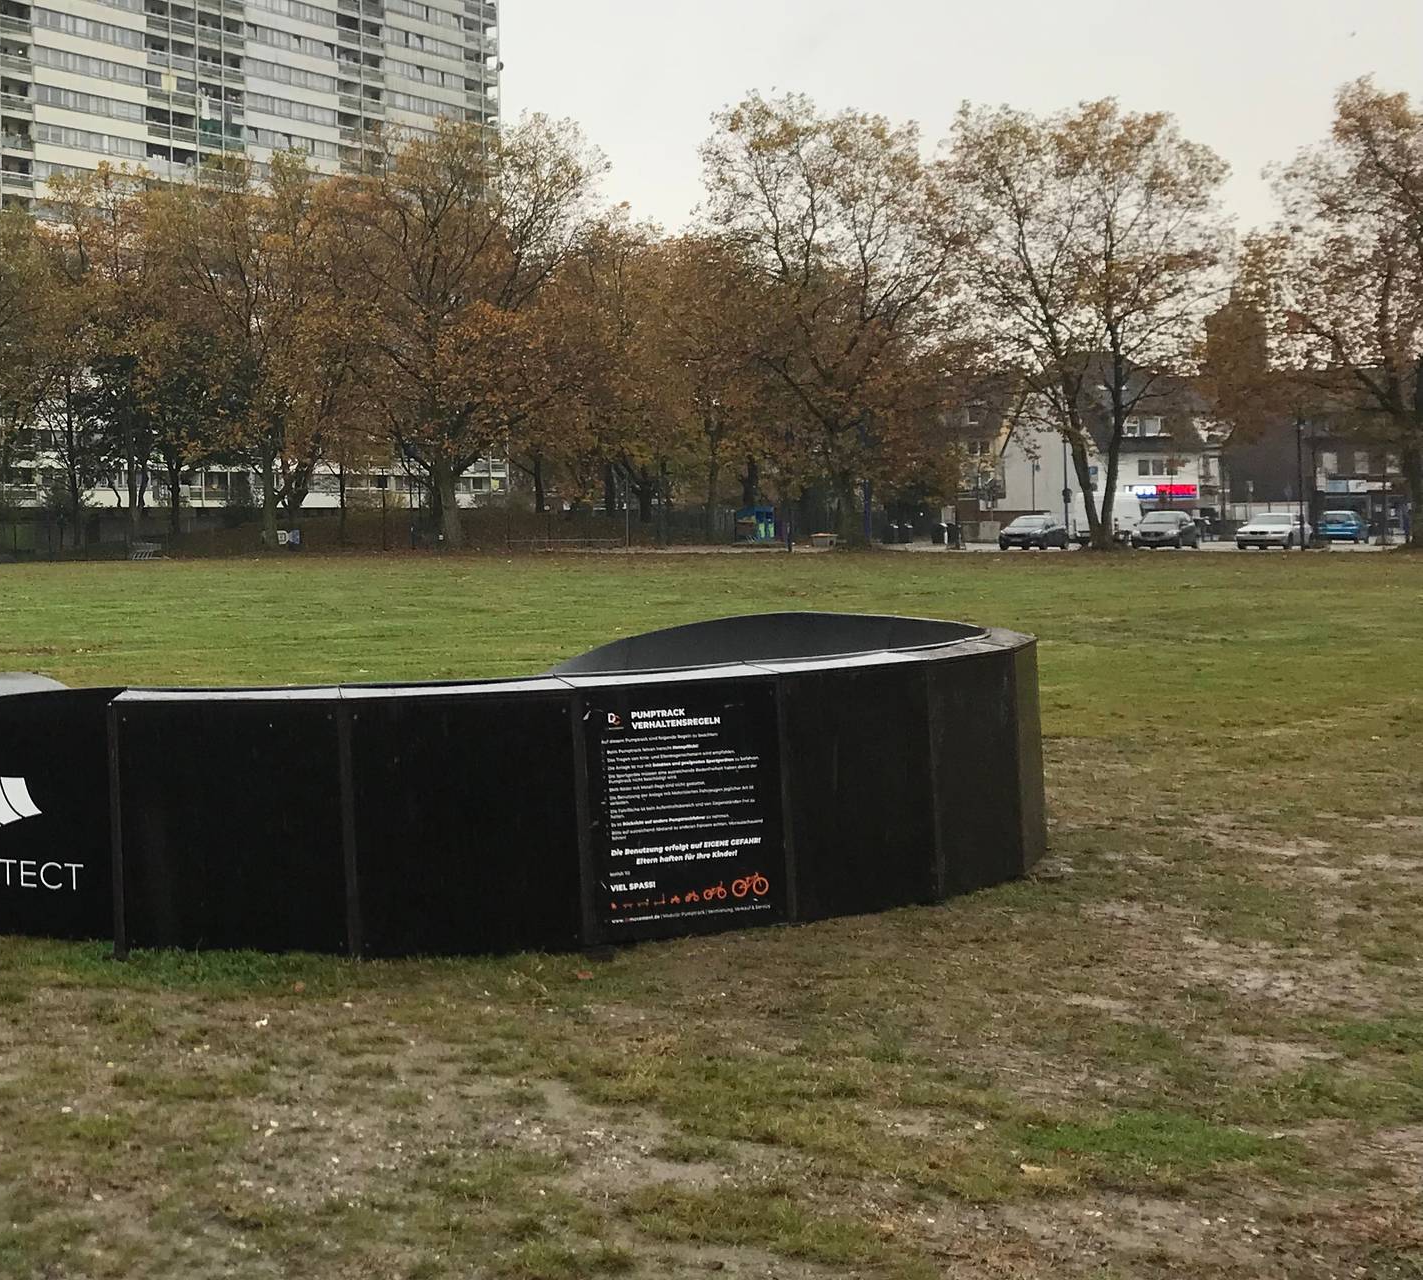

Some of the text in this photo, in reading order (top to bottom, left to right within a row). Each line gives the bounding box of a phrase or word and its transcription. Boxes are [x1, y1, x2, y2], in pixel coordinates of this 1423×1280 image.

[631, 708, 686, 719] PUMPTRACK
[631, 717, 721, 730] VERHALTENSREGELN
[610, 837, 762, 857] Die Benutzung erfolgt auf EIGENE GEFAHR!
[636, 857, 658, 865] Eltern
[659, 855, 684, 863] haften
[684, 853, 696, 861] für
[711, 849, 738, 858] Kinder!
[610, 881, 656, 892] VIEL SPASS!
